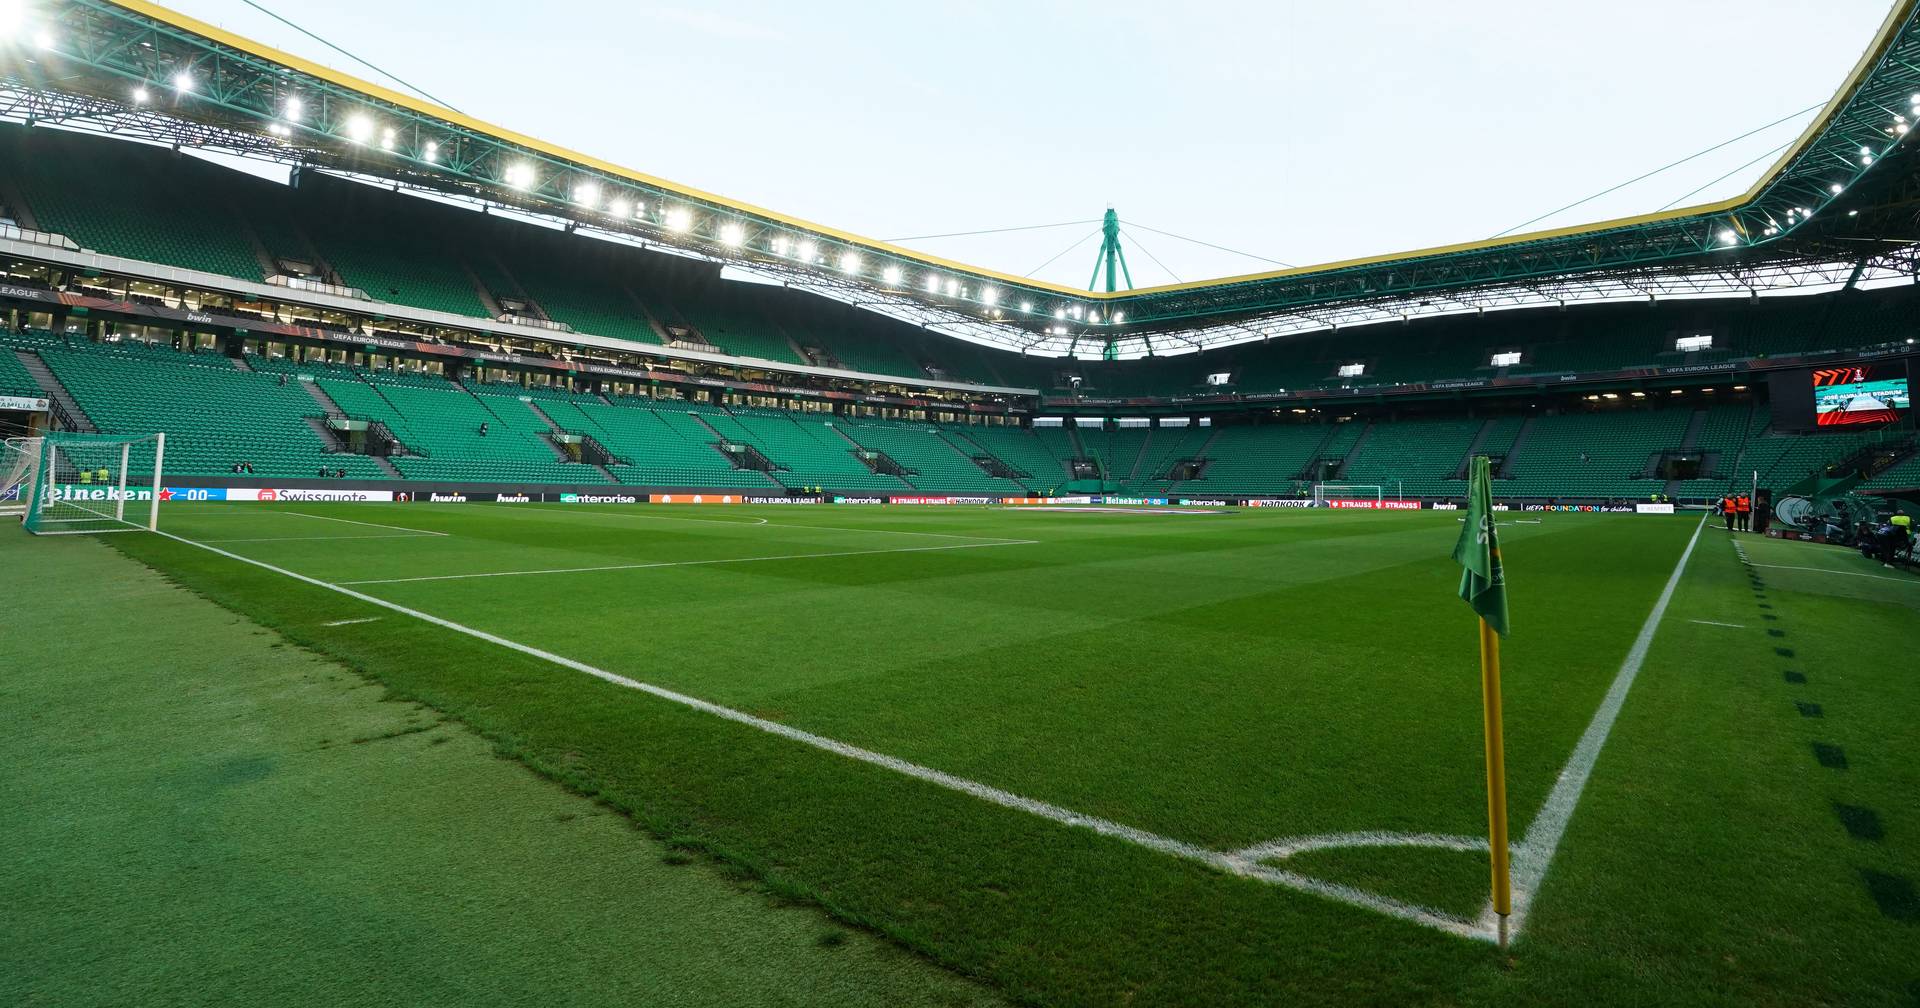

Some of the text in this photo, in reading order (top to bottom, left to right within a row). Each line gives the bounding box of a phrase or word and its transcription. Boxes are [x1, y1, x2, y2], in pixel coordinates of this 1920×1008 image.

[0, 286, 40, 298] EAGUE
[187, 312, 212, 323] bwin
[333, 333, 406, 348] UEFA EUROPA LEAGUE
[604, 367, 622, 375] EUROPA
[623, 369, 641, 377] LEAGUE
[1684, 365, 1710, 373] EUROPA
[1710, 363, 1736, 371] LEAGUE
[0, 400, 32, 410] AMÍLIA
[279, 490, 367, 501] Swissquote
[430, 491, 467, 502] bwin
[496, 492, 530, 503] bwin
[563, 494, 636, 504] enterprise
[837, 496, 882, 505] enterprise
[1106, 496, 1142, 504] Heineken
[1182, 498, 1226, 506] enterprise
[1341, 501, 1418, 510] STRAUSS STRAUSS
[1432, 502, 1457, 511] bwin
[1492, 503, 1509, 513] win
[1525, 504, 1544, 512] UEFA
[1600, 504, 1609, 512] for
[1610, 504, 1633, 512] children
